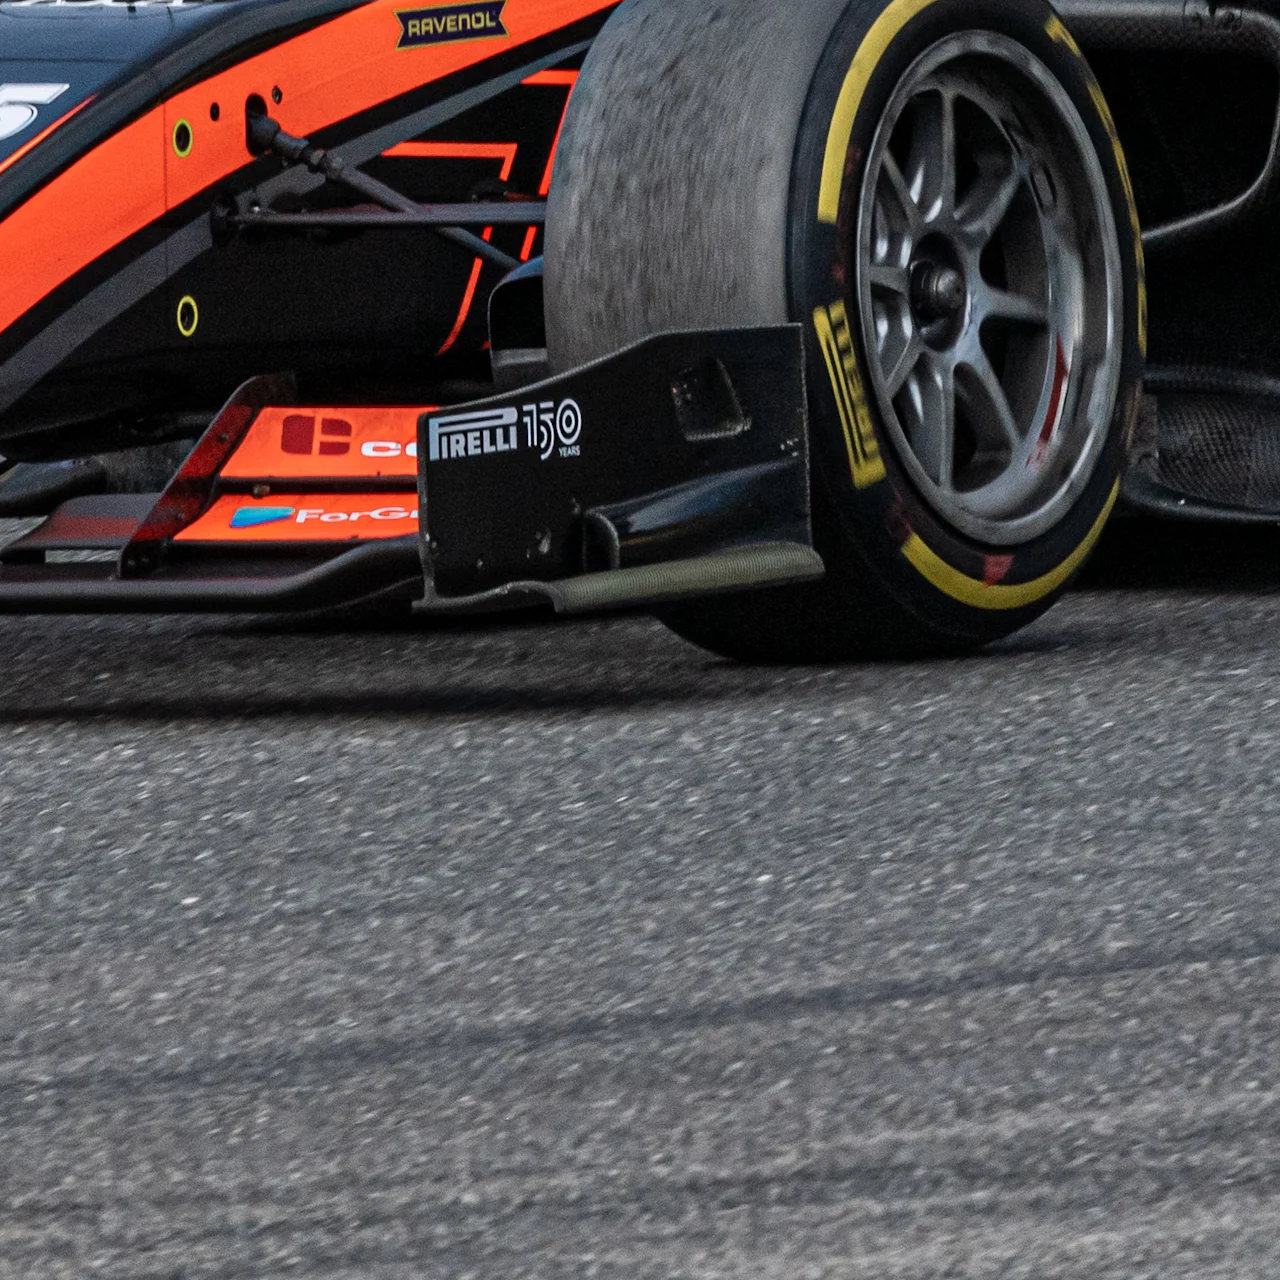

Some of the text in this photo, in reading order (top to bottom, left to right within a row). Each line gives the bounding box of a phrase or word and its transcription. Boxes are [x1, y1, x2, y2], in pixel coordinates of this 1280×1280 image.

[408, 10, 497, 37] RAVENOL
[428, 398, 582, 461] PIRELLI 150
[558, 445, 581, 458] YEARS
